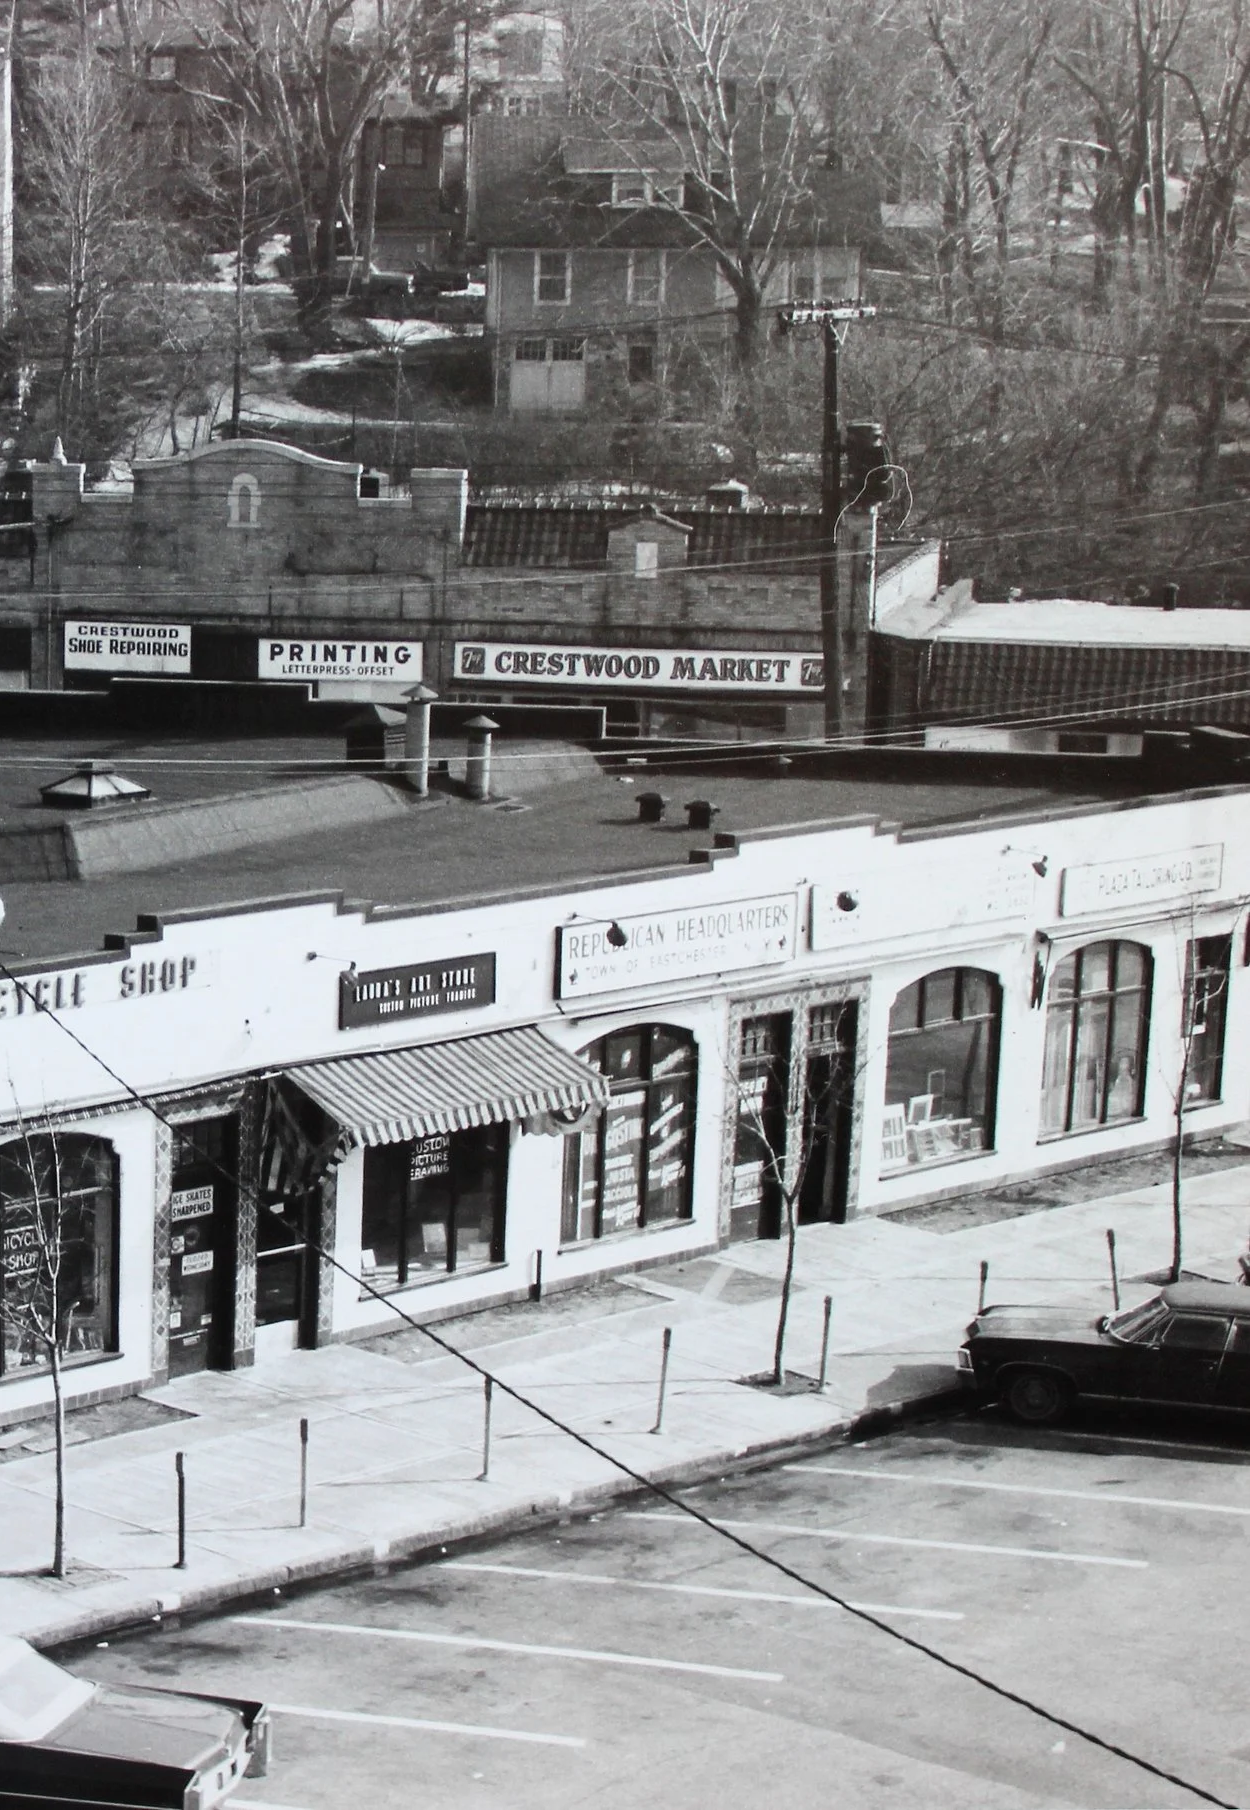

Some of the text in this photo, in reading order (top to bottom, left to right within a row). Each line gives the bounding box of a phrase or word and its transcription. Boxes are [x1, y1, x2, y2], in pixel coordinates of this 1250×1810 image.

[69, 637, 188, 657] SHOE REPAIRING
[78, 625, 179, 639] CRESTWOOD
[269, 643, 411, 664] PRINTING
[494, 651, 792, 683] CRESTWOOD MARKET
[569, 923, 665, 959] REPUICAN
[676, 904, 789, 943] HEADQUARTERS
[119, 955, 196, 998] SHOP
[356, 967, 475, 1002] LAURA'S ART STORE
